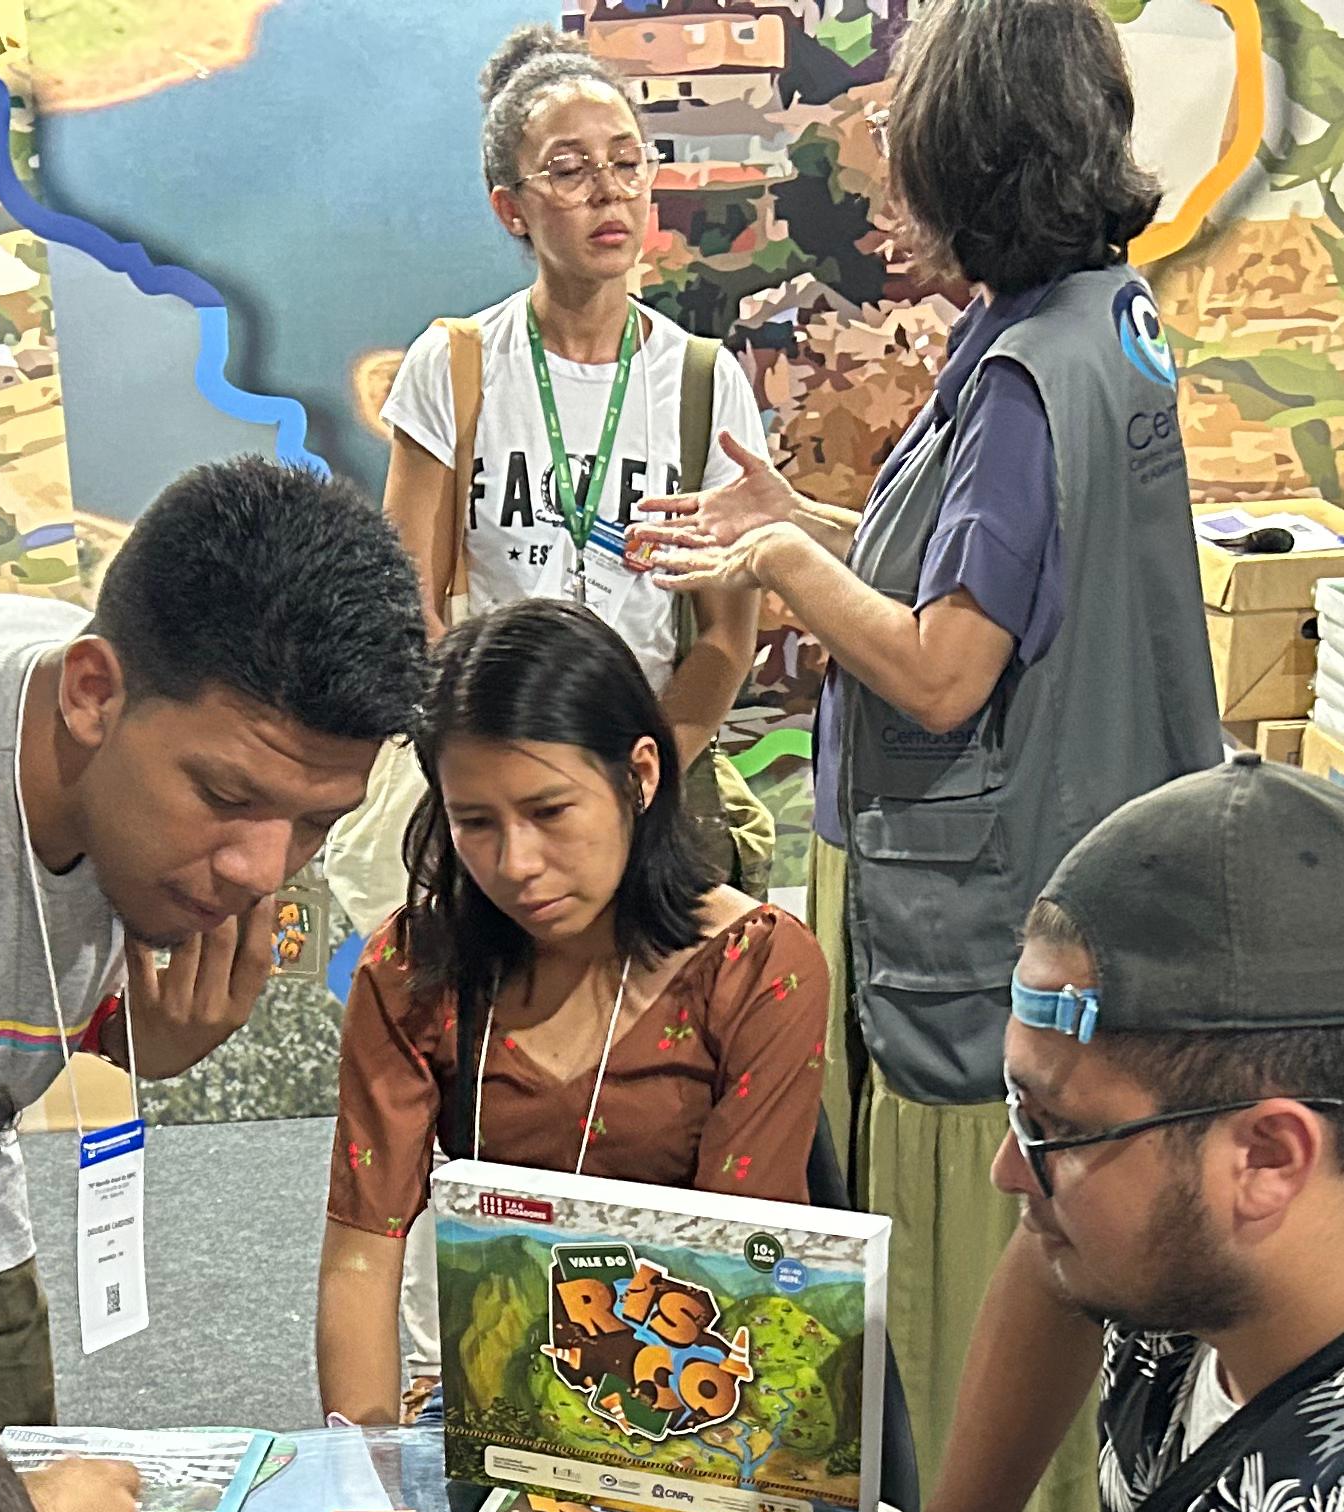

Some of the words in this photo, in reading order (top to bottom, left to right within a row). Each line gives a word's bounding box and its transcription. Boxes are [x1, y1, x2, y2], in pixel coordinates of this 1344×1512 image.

[529, 545, 553, 565] ES
[753, 1244, 775, 1255] 10+
[569, 1257, 602, 1268] VALE
[605, 1257, 626, 1267] DO
